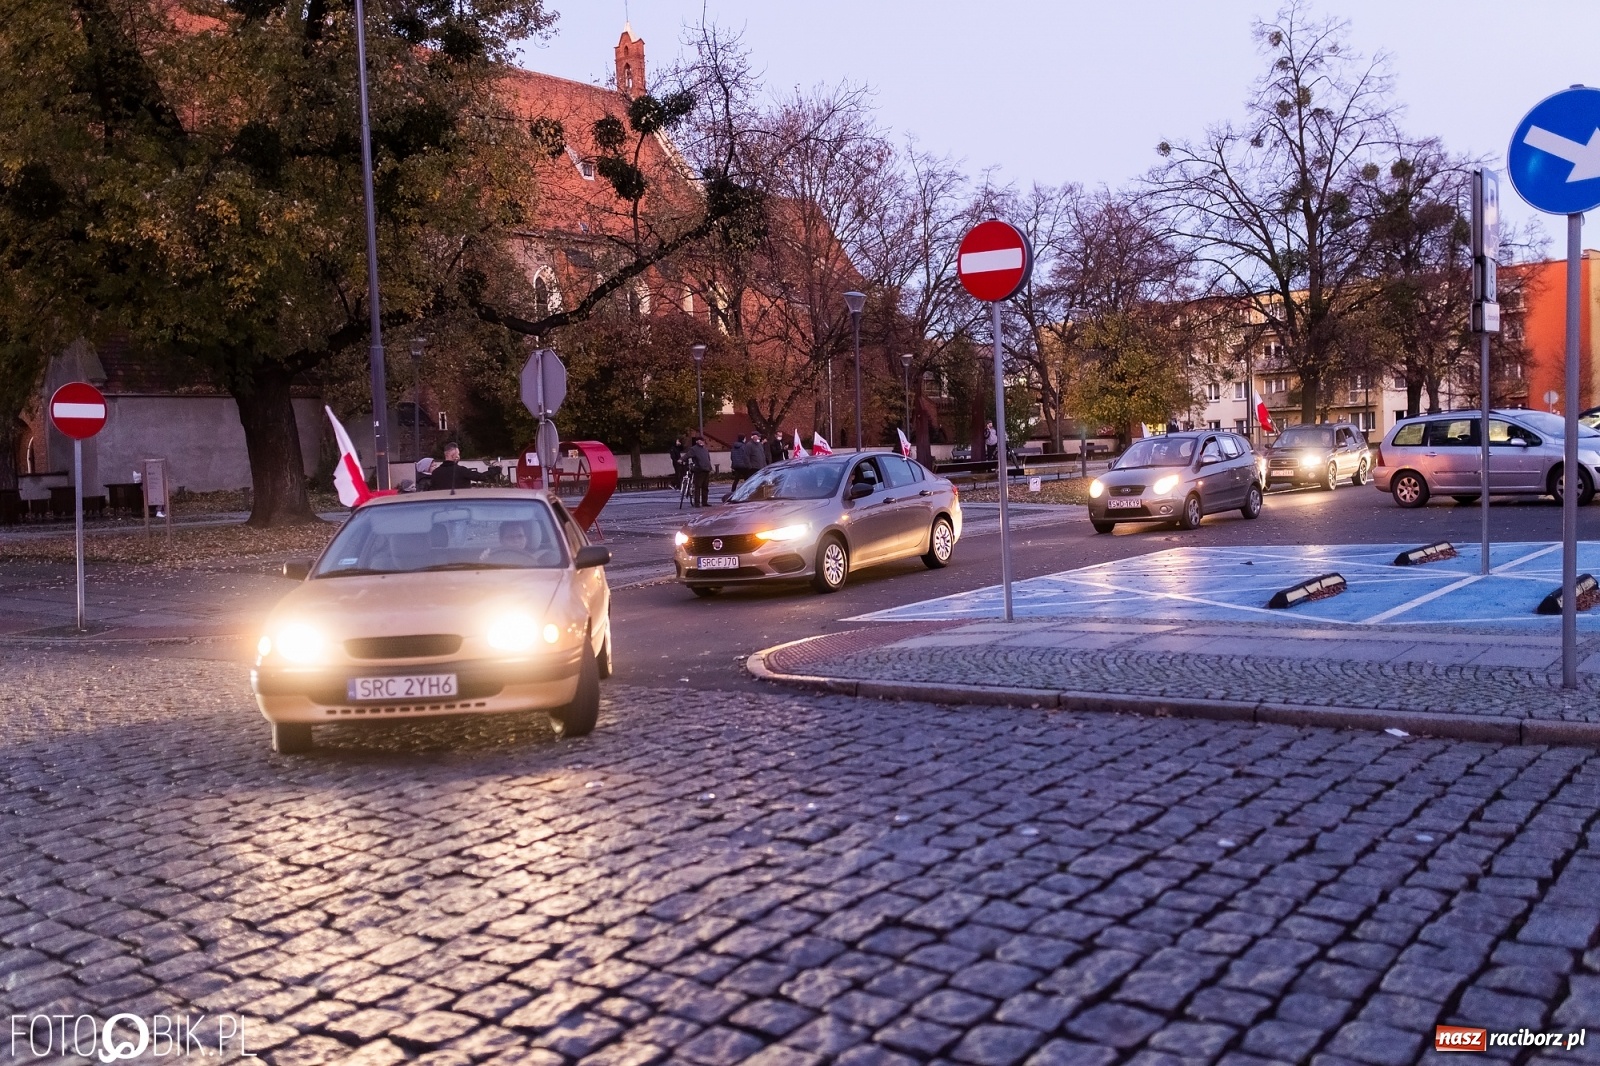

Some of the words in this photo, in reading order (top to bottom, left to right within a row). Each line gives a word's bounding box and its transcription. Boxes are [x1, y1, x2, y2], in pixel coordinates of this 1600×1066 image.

[702, 558, 716, 567] SRC
[360, 679, 396, 697] SRC
[404, 676, 452, 696] 2YH6
